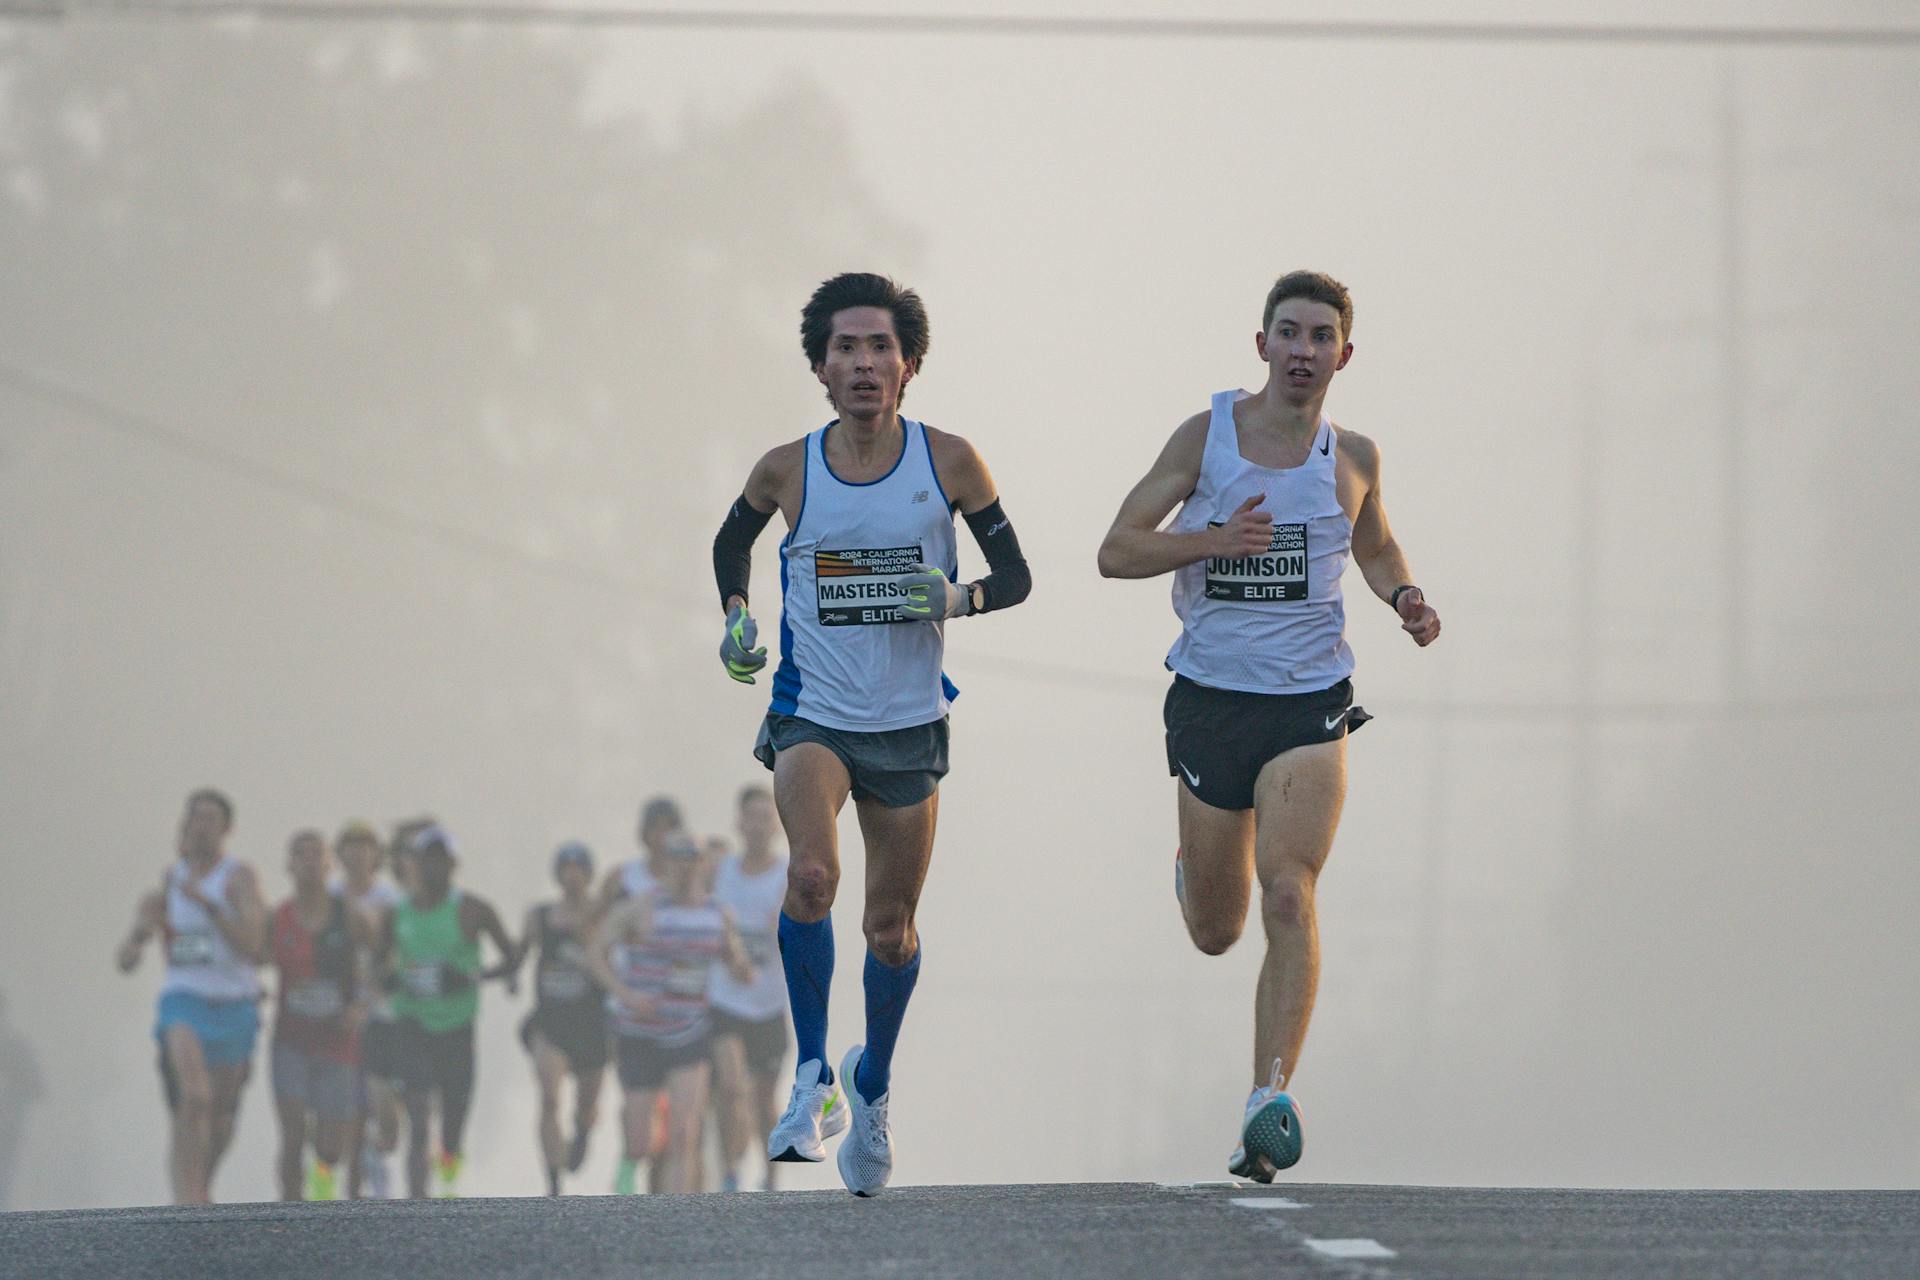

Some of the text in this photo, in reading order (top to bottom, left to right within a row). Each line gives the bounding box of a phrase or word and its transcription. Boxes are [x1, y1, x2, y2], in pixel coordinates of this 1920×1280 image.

[1267, 540, 1305, 550] ARATHON
[840, 551, 862, 560] 2024
[868, 548, 920, 559] CALIFORNIA
[852, 556, 920, 566] INTERNATIONAL
[1208, 556, 1304, 577] JOHNSON
[871, 564, 913, 573] MARATHO
[820, 582, 909, 600] MASTERSO
[1244, 586, 1286, 598] ELITE
[862, 609, 903, 622] ELITE
